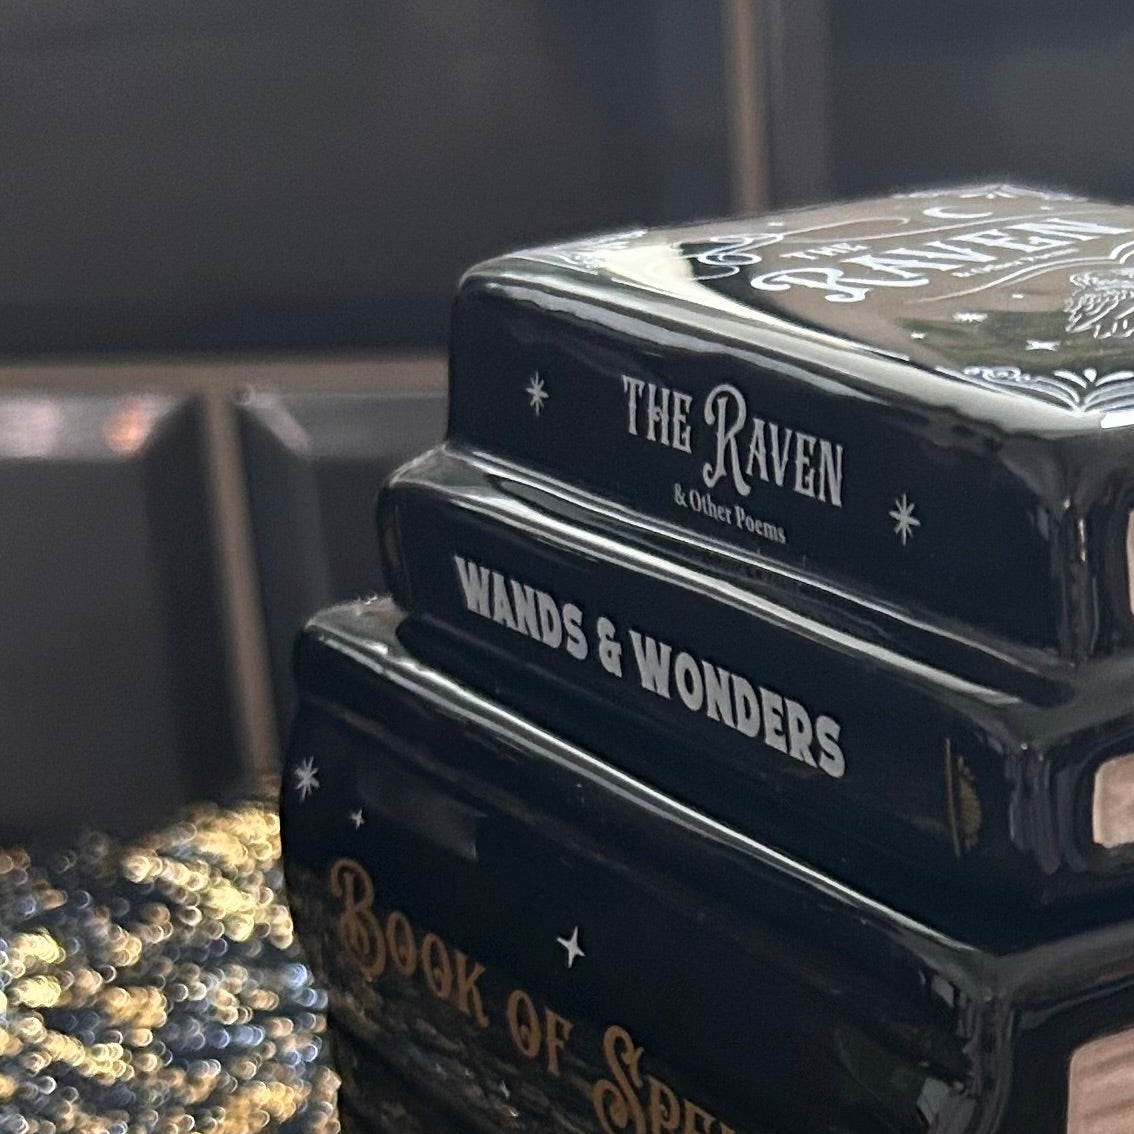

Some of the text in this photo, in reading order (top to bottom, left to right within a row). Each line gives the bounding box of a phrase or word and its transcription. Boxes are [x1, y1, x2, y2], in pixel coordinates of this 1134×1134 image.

[780, 240, 868, 261] THE
[621, 374, 844, 508] THE RAVEN
[674, 482, 786, 544] & Other Poems
[454, 555, 846, 779] WANDS & WONDERS
[330, 858, 489, 1028] BOOK
[505, 989, 576, 1077] OF
